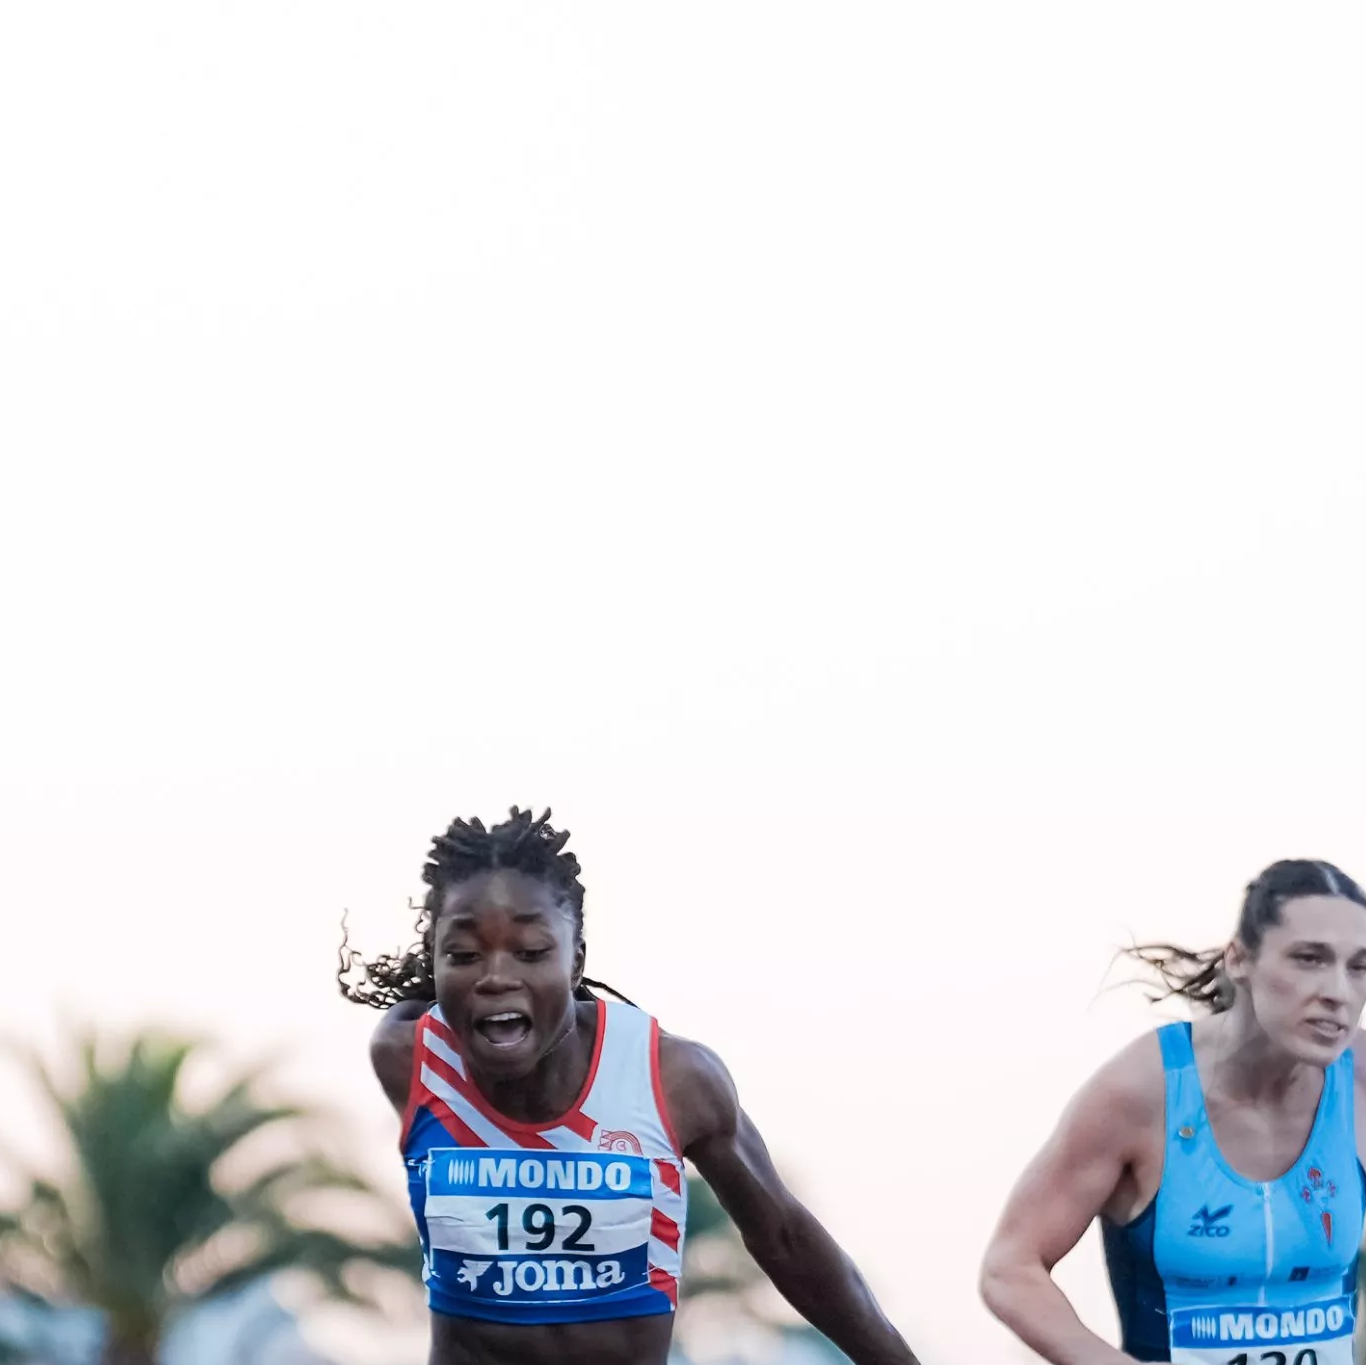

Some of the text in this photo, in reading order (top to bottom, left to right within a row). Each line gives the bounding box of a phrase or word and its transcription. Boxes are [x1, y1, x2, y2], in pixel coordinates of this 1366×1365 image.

[478, 1158, 631, 1191] MONDO
[485, 1203, 595, 1251] 192
[1219, 1305, 1343, 1341] MONDO
